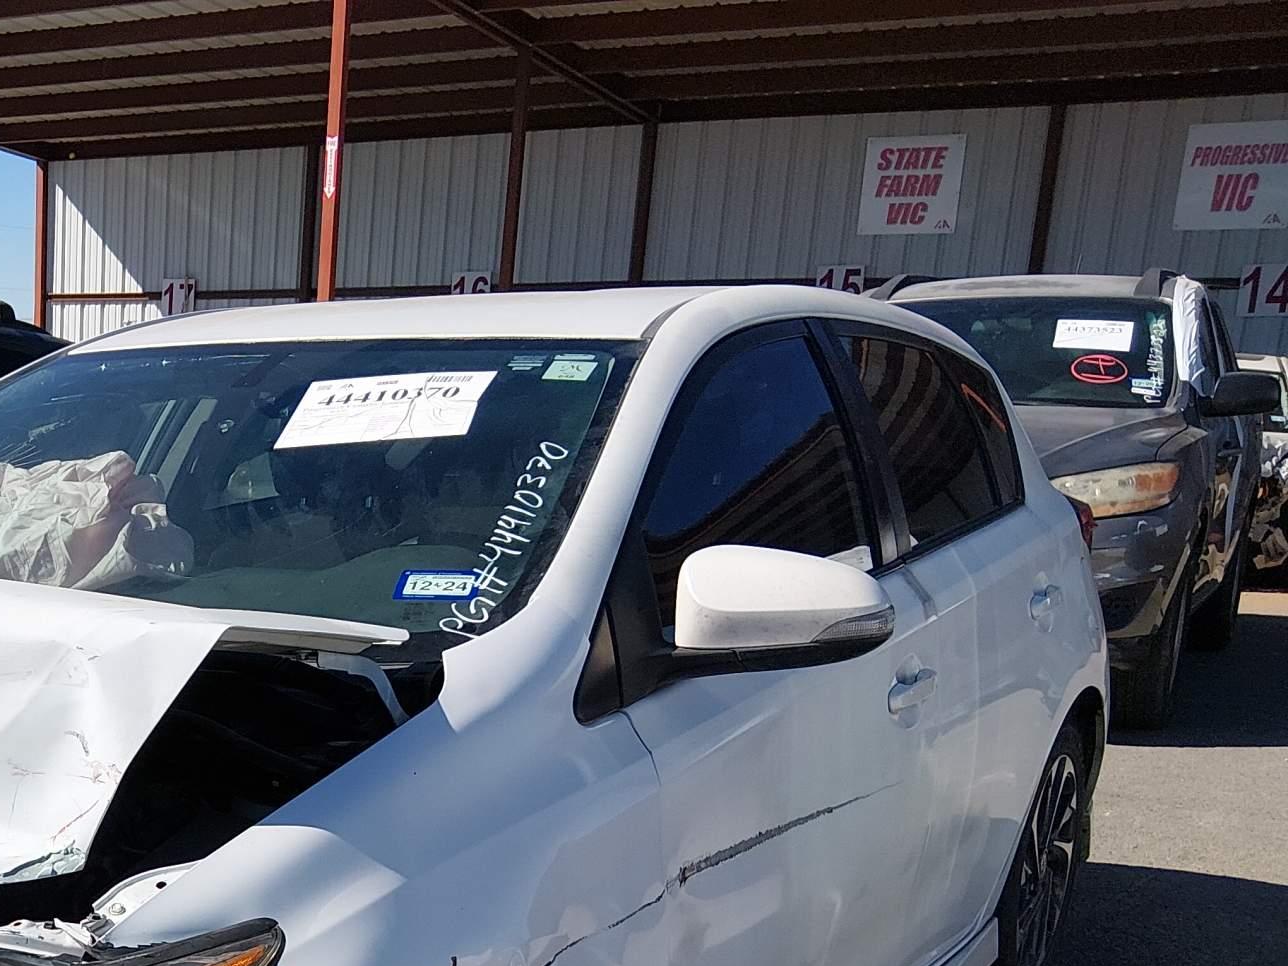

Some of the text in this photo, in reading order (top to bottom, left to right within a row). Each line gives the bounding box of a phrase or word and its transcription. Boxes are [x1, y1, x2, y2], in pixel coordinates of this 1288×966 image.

[877, 146, 949, 171] STATE
[875, 173, 943, 198] FARM
[1210, 172, 1260, 212] VIC
[886, 201, 929, 226] VIC
[819, 268, 861, 295] 15
[1243, 265, 1288, 313] 14
[318, 385, 461, 407] 44410370
